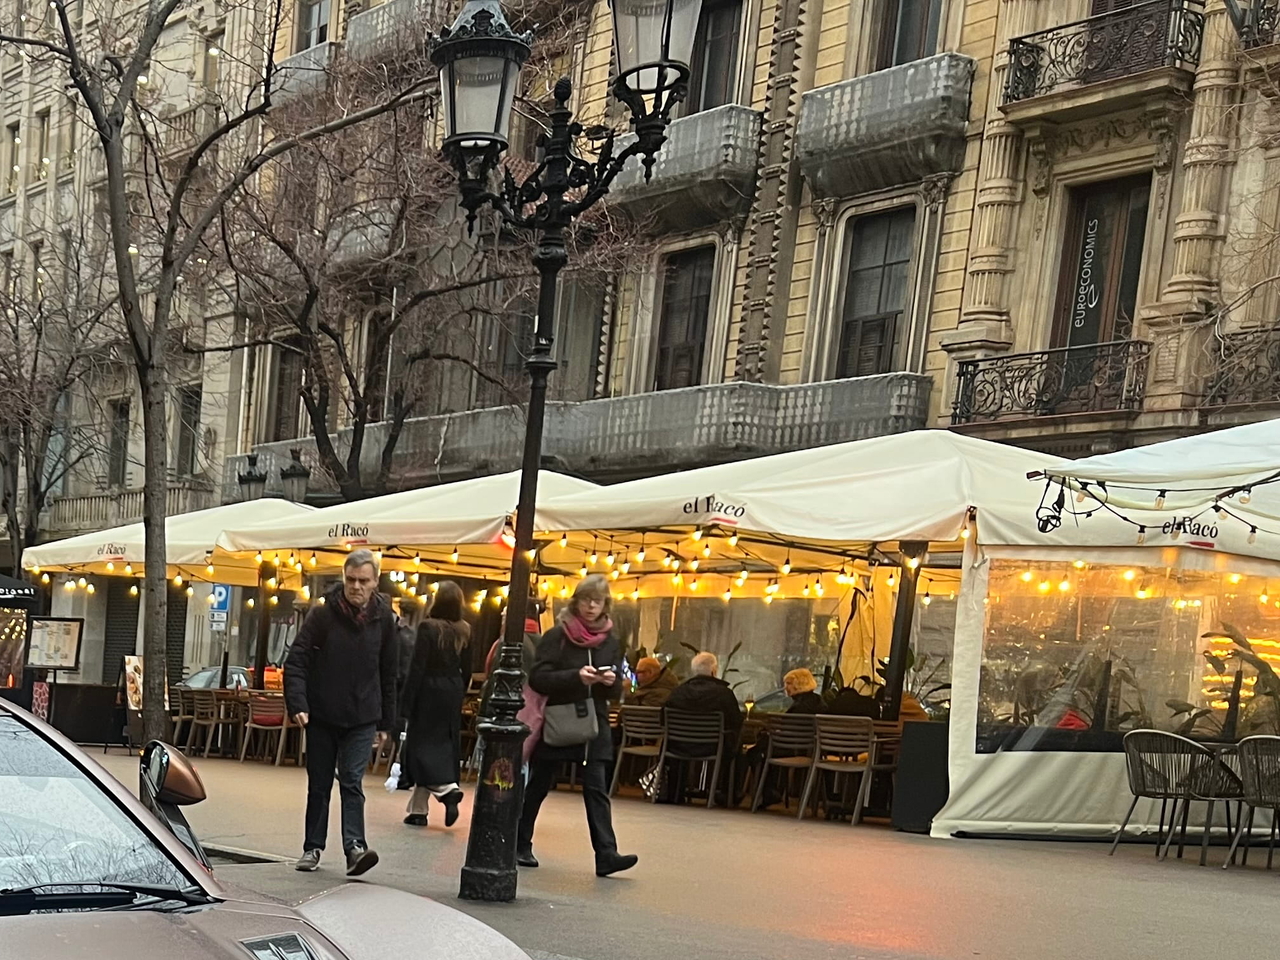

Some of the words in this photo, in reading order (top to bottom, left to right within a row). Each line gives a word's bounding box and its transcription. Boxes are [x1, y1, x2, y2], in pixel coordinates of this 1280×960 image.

[683, 496, 699, 514] el
[705, 494, 748, 518] Racó
[328, 523, 339, 538] el
[341, 522, 369, 537] Racó
[1162, 516, 1177, 535] el
[1182, 516, 1219, 539] Racó
[97, 543, 106, 555] el
[106, 542, 127, 555] Racó
[213, 586, 227, 609] P
